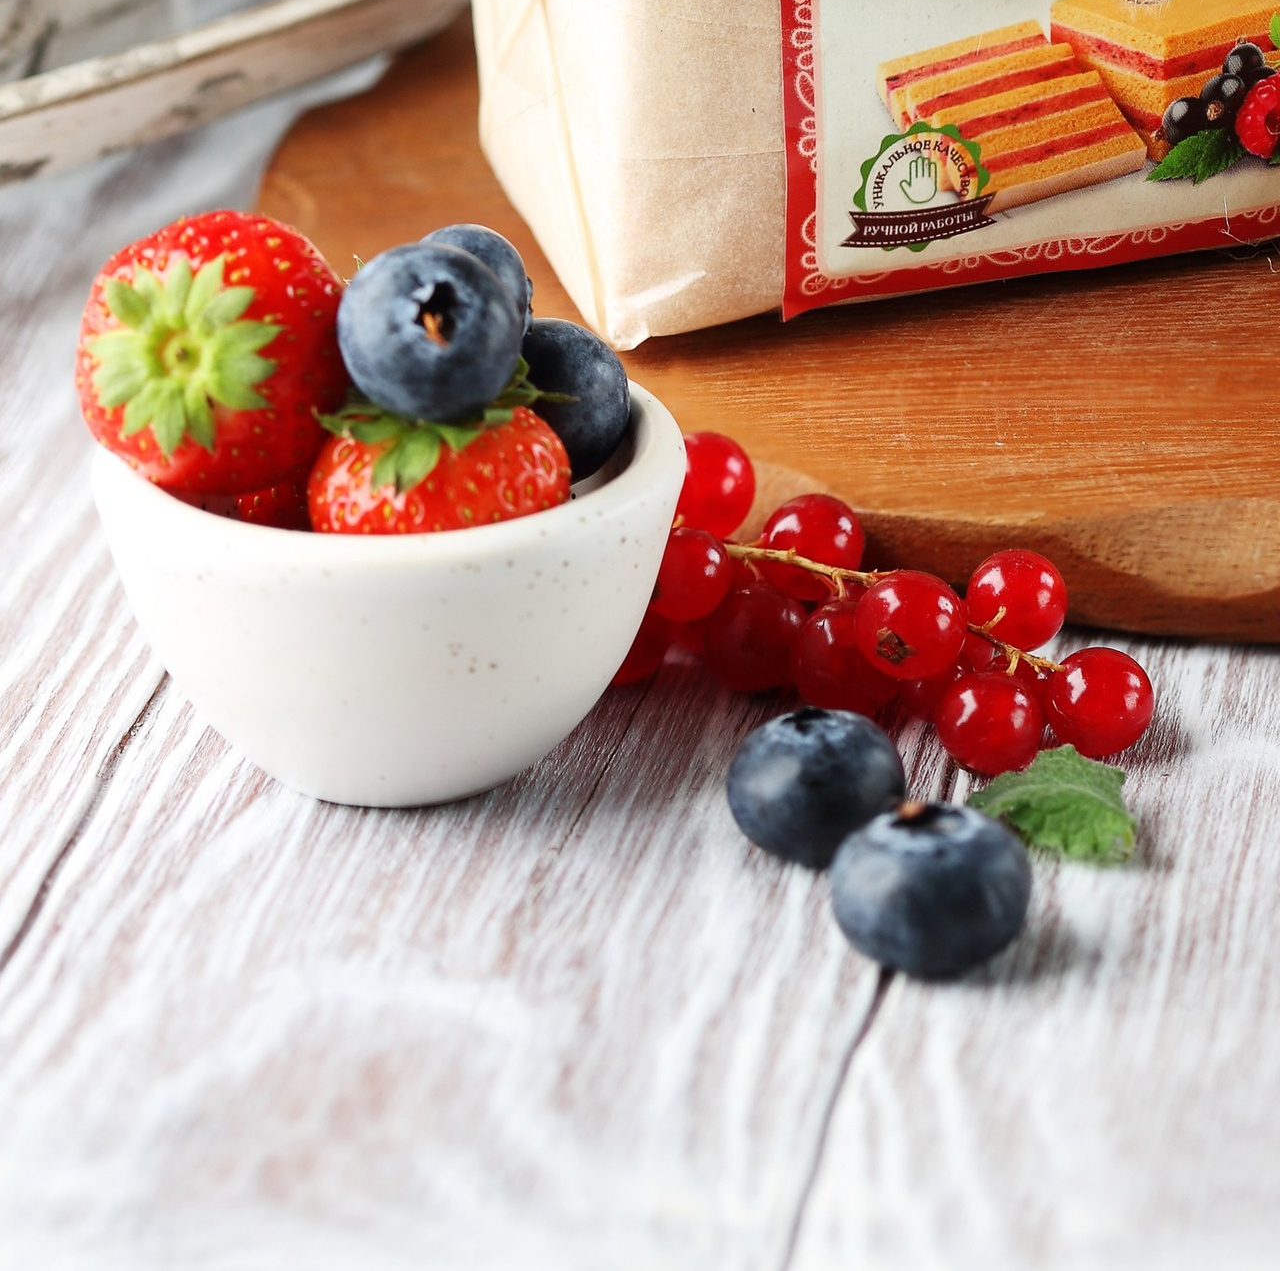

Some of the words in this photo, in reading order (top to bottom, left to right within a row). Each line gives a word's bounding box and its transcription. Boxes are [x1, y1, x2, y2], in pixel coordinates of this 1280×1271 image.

[872, 140, 931, 210] УНИКАЛЬНОЕ
[932, 140, 971, 198] КАЧЕСТВО
[863, 221, 918, 236] РУЧНОЙ
[920, 210, 974, 231] РАБОТЫ
